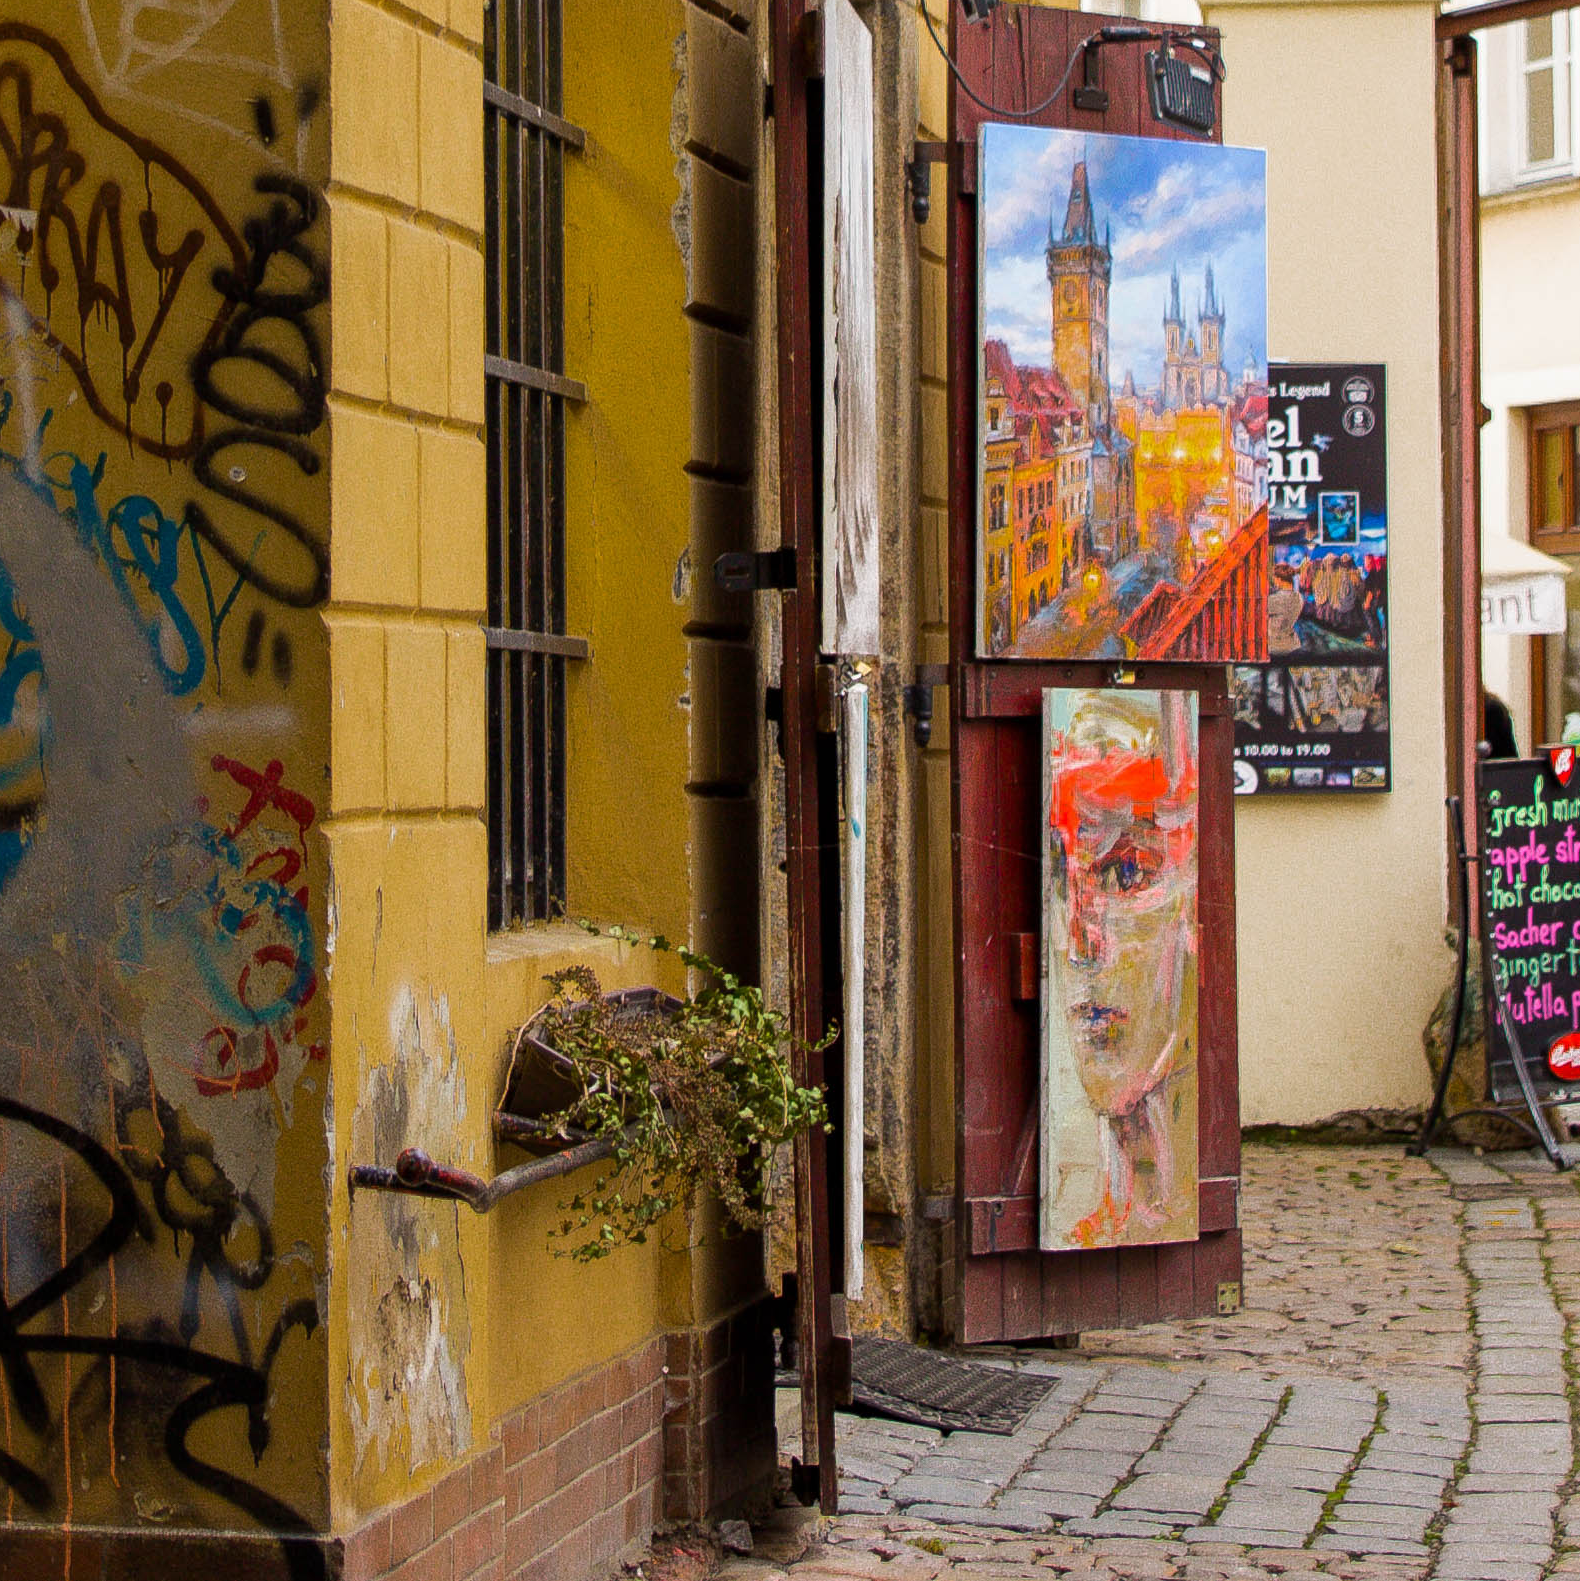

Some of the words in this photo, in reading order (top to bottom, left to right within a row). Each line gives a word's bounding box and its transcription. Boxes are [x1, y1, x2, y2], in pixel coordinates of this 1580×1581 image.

[1278, 380, 1331, 401] Legend
[1489, 773, 1548, 838] fresh
[1491, 829, 1550, 885] apple
[1492, 866, 1528, 909] hot
[1494, 905, 1564, 950] Sacher
[1497, 952, 1567, 989] ginger
